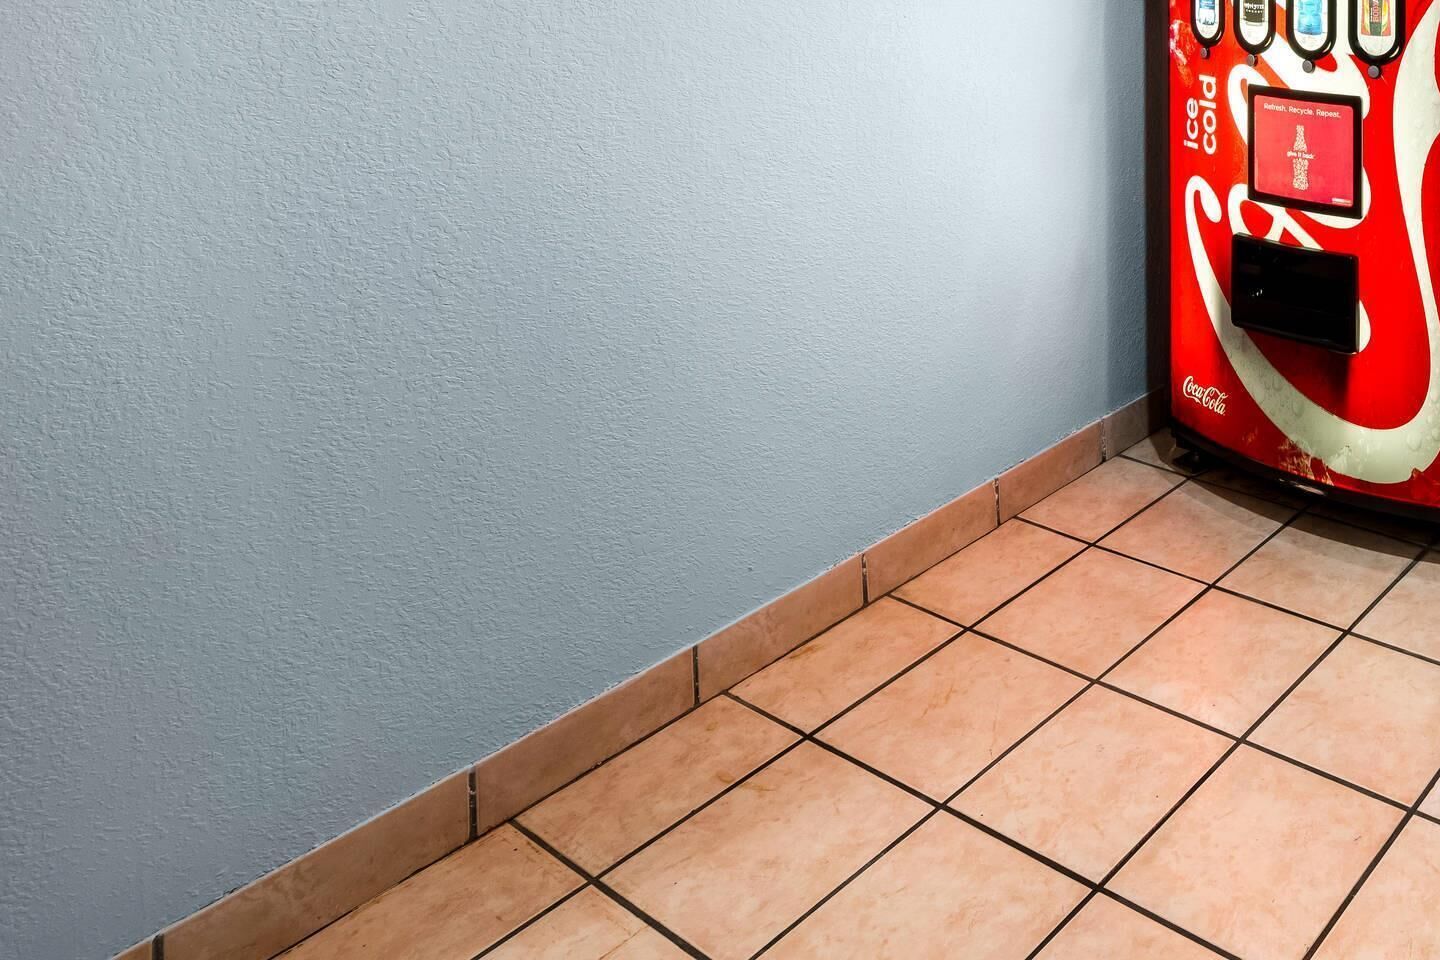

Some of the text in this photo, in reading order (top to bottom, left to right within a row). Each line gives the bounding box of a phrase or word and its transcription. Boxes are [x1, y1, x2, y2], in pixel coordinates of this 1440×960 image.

[1183, 97, 1199, 150] ice
[1199, 74, 1217, 155] cold
[1263, 102, 1341, 118] Refresh. Recycle. Repeat.
[1183, 376, 1228, 415] Coca-Cola
